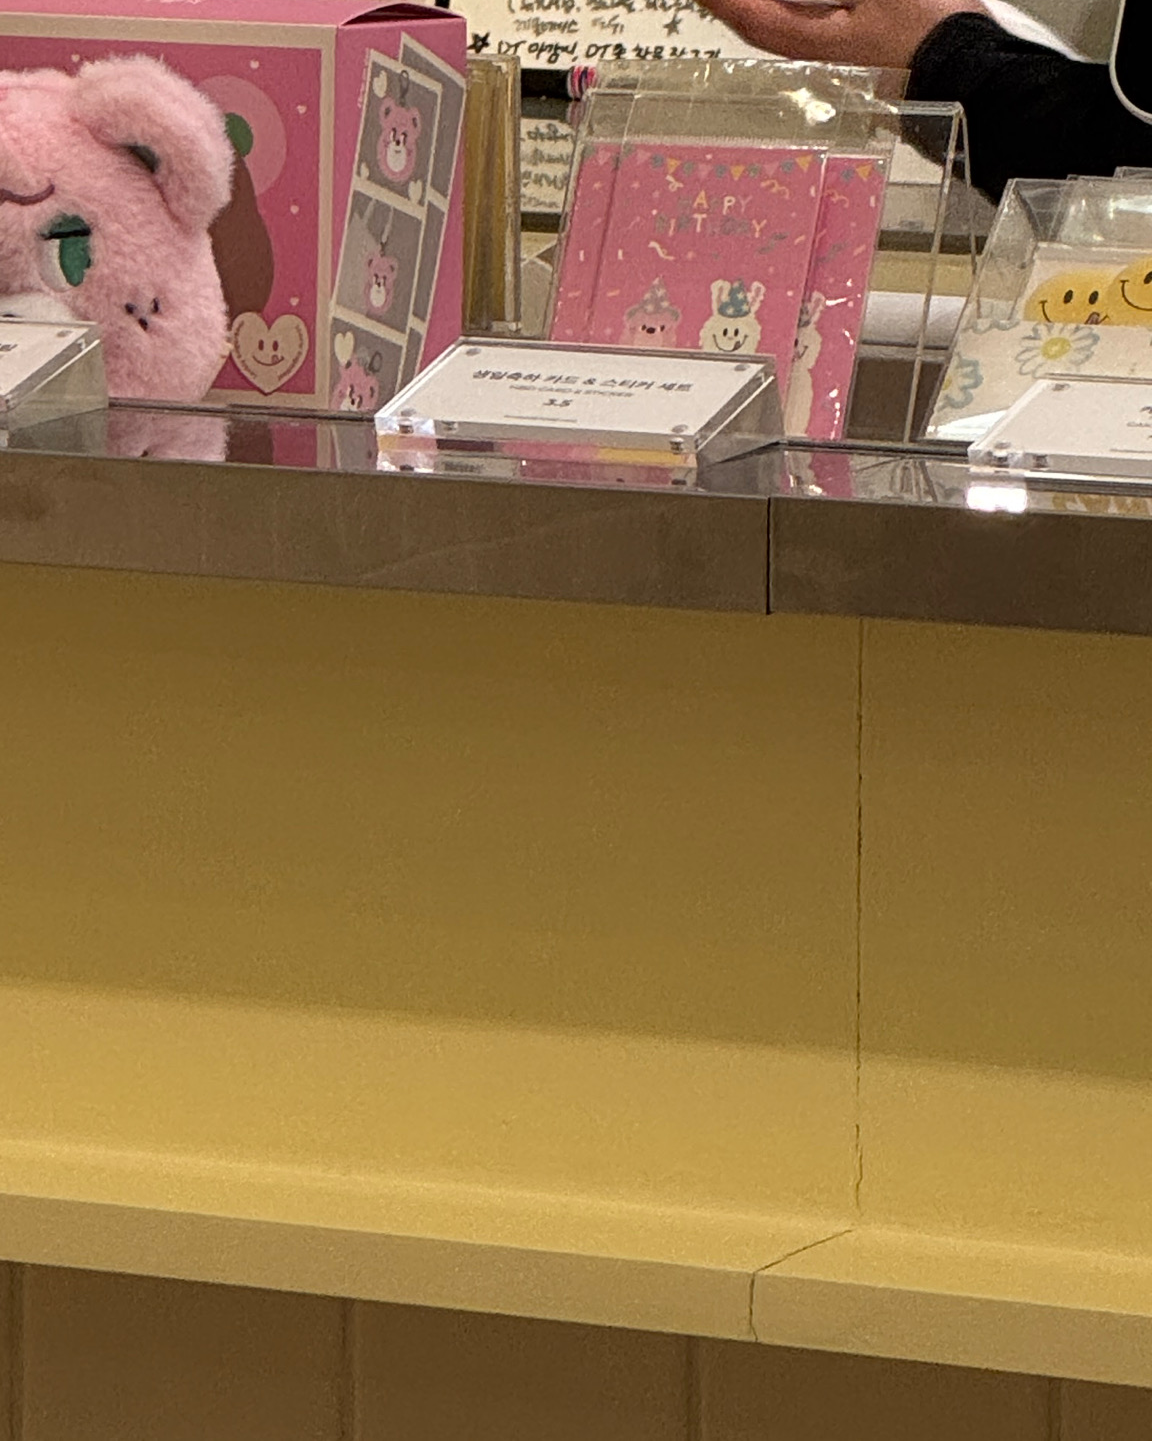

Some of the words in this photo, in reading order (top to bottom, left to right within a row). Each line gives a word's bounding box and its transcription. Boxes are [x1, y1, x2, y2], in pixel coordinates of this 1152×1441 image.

[472, 369, 541, 383] 생일축하
[543, 373, 581, 385] 카드
[582, 377, 597, 385] &
[599, 377, 655, 390] 스티커
[656, 382, 695, 393] 세트
